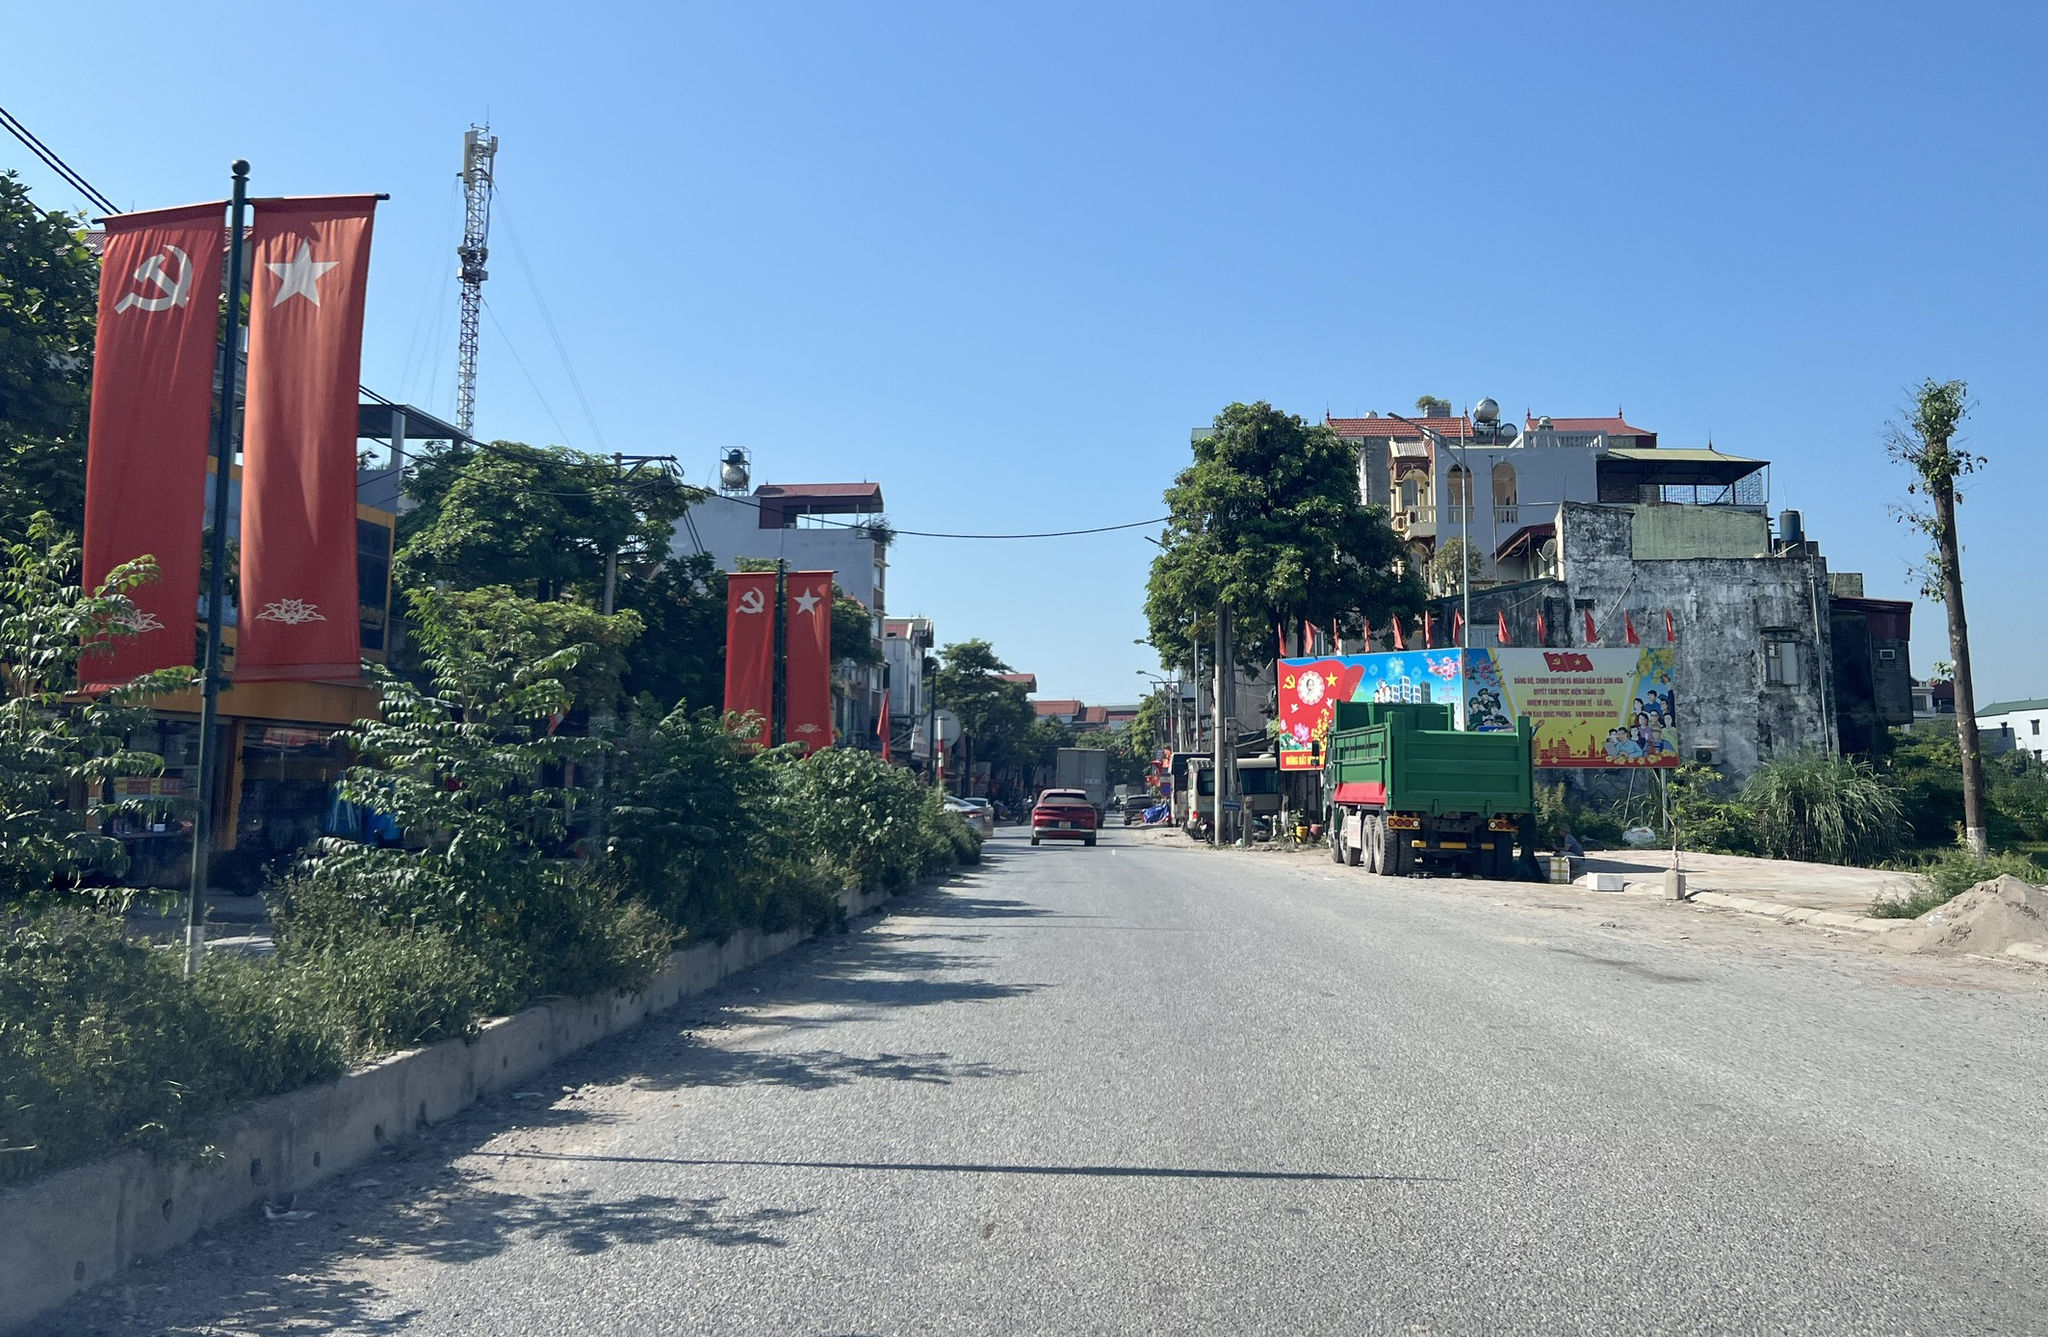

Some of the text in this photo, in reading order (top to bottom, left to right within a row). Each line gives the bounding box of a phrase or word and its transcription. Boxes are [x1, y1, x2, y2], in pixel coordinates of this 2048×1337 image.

[1533, 687, 1546, 695] QUYẾT
[1548, 687, 1557, 695] TÂM
[1558, 687, 1570, 695] THỰC
[1571, 687, 1581, 695] HIỆN
[1583, 687, 1597, 695] THẮNG
[1527, 698, 1541, 706] NHIỆM
[1543, 698, 1548, 706] VỤ
[1549, 698, 1560, 706] PHÁT
[1561, 698, 1574, 706] TRIỂN
[1576, 698, 1586, 706] KINH
[1586, 698, 1592, 706] TẾ
[1596, 698, 1602, 706] XÃ
[1556, 710, 1571, 718] PHÒNG
[1575, 710, 1582, 718] AN
[1583, 710, 1594, 718] NINH
[1595, 710, 1605, 718] NĂM
